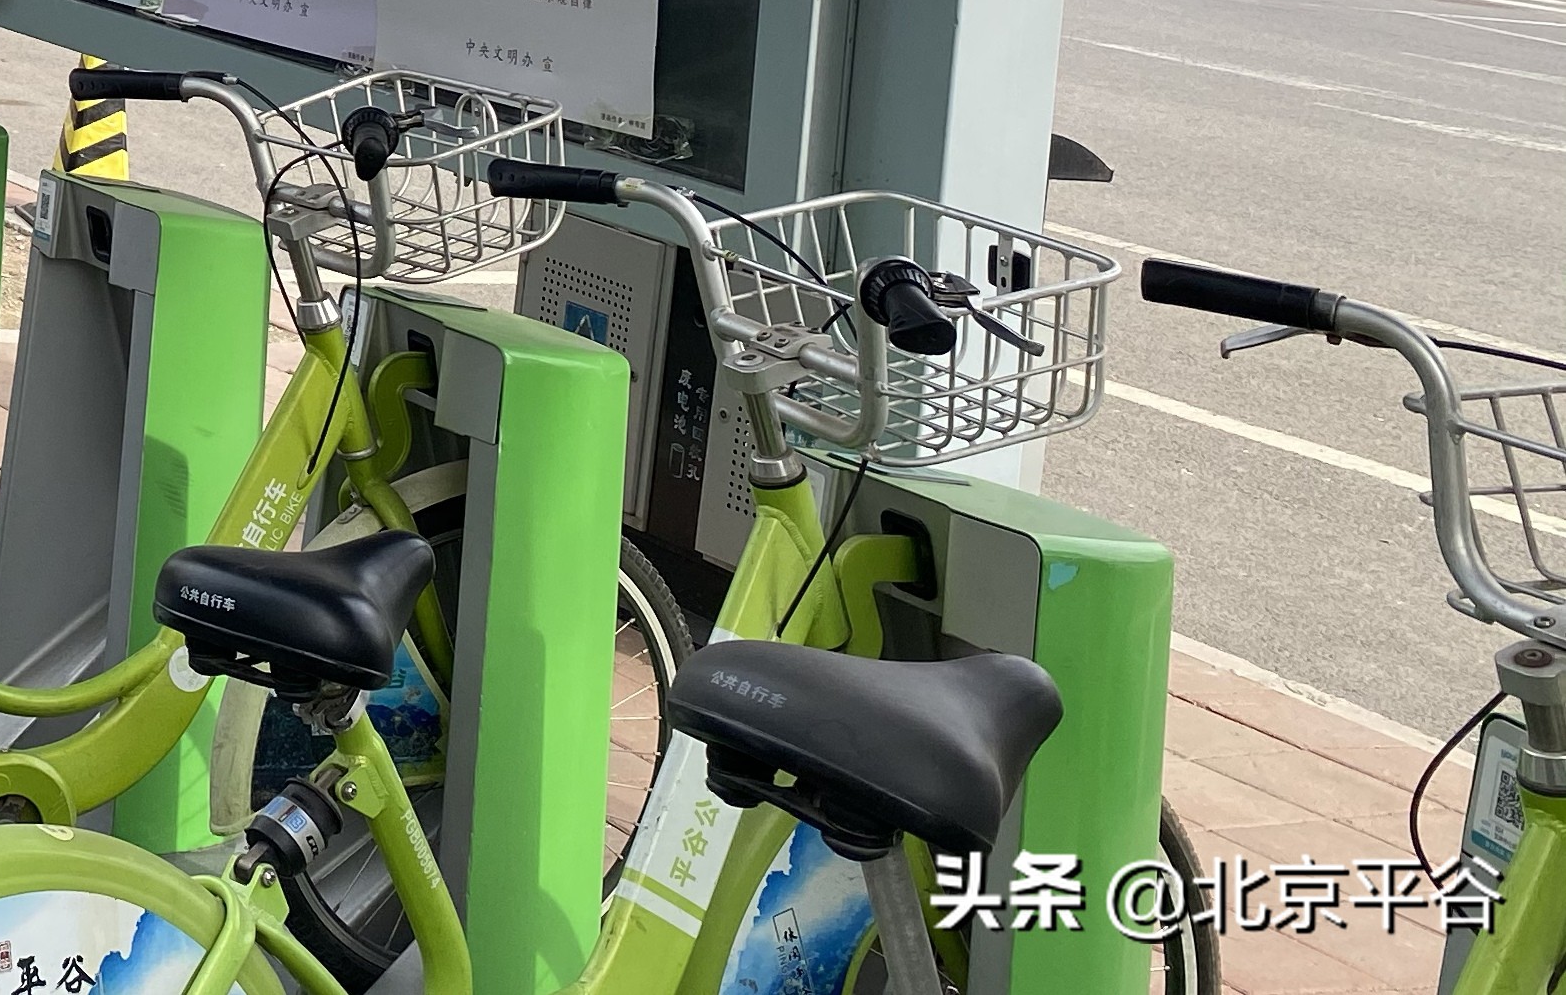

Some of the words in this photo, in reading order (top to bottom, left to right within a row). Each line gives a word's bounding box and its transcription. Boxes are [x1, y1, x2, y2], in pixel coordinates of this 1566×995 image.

[466, 38, 533, 68] 中央文明办
[235, 477, 288, 549] 自行车
[280, 490, 304, 525] BIKE
[179, 585, 236, 612] 公共自行车
[711, 669, 787, 709] 公共自行车
[669, 800, 721, 887] 平谷公
